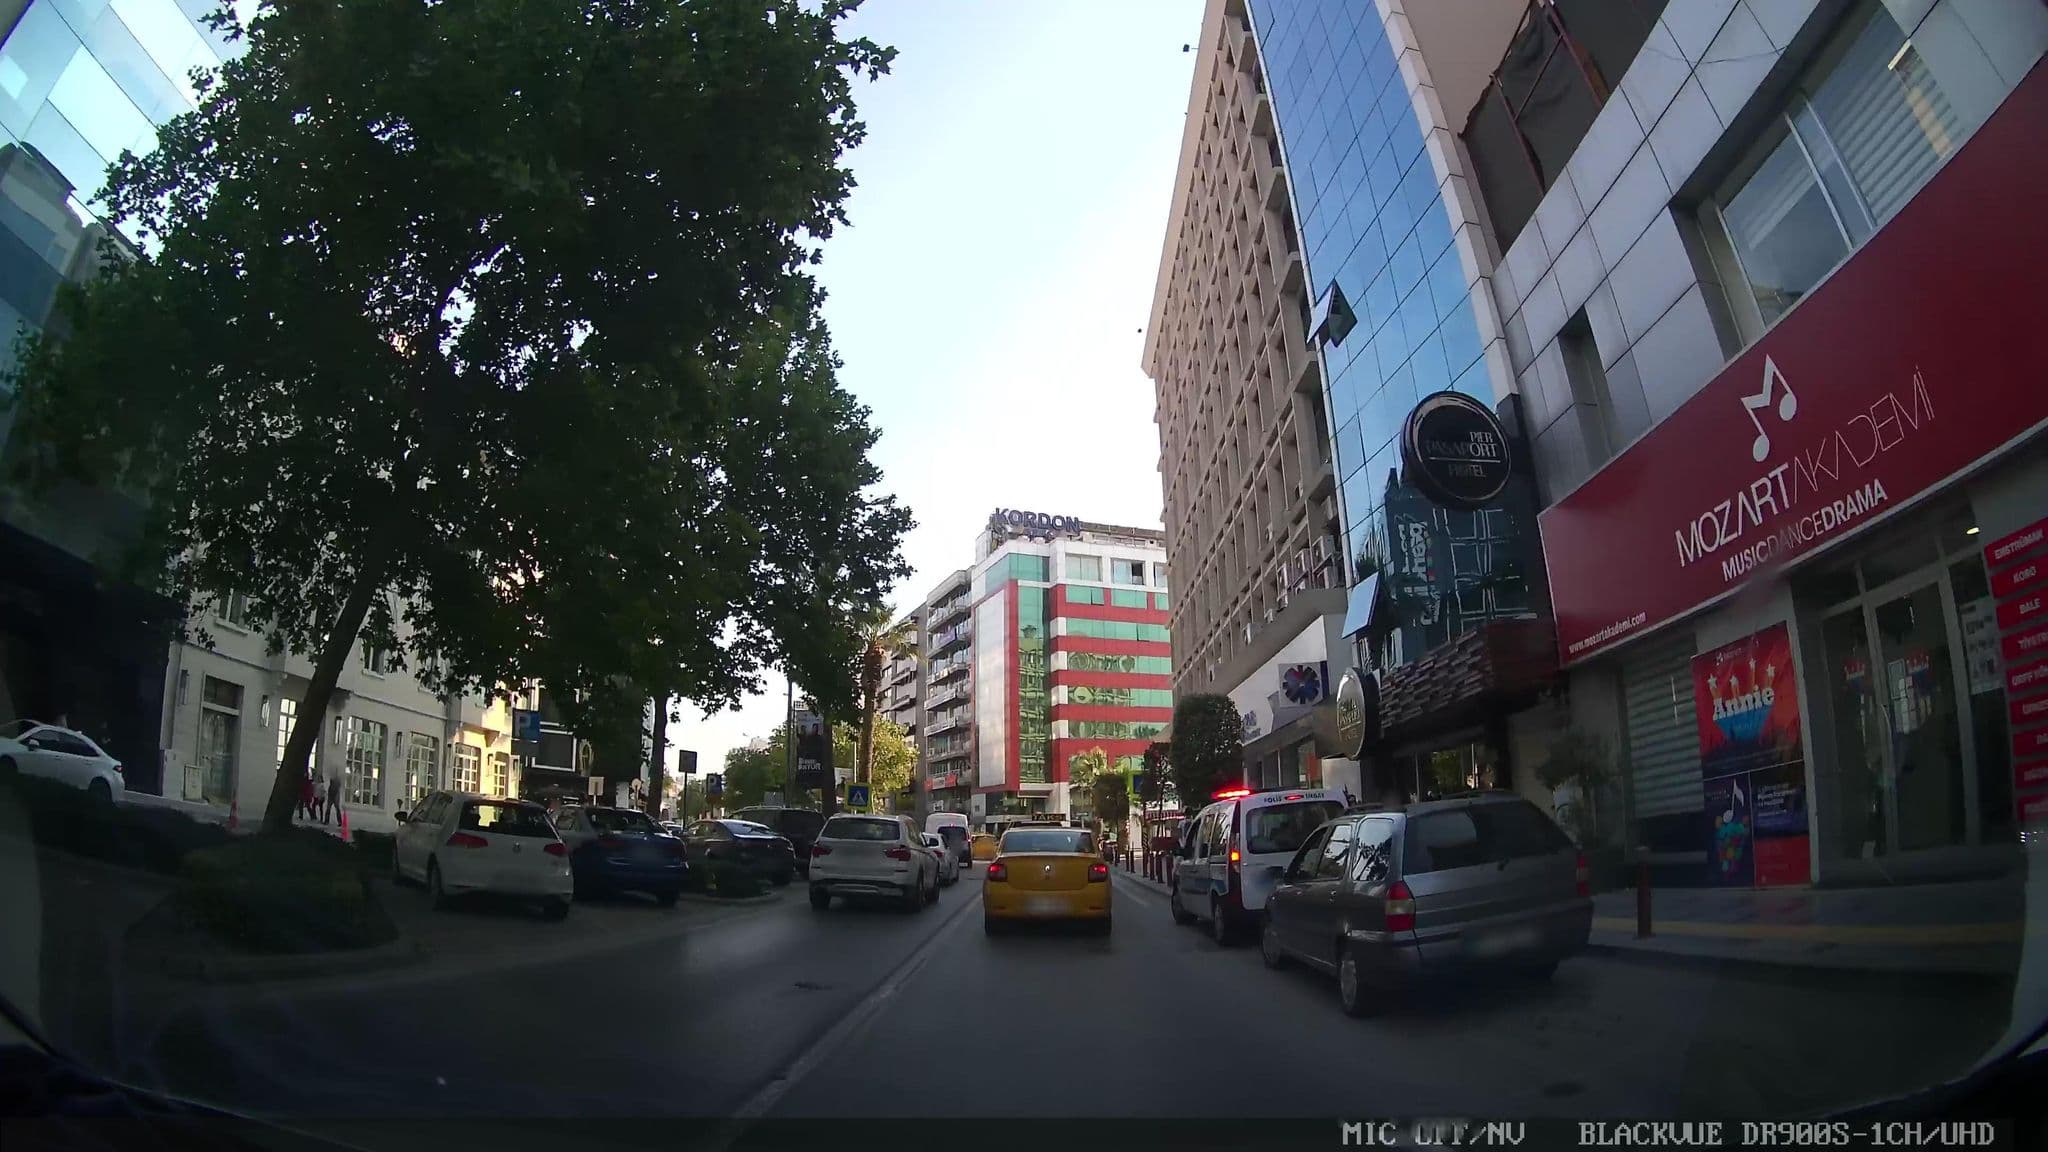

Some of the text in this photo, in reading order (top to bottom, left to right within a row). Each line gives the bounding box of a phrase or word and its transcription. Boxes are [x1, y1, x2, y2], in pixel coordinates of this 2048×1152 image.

[1469, 431, 1494, 443] PIER
[996, 507, 1080, 533] KORDON
[1568, 611, 1647, 654] www.mozartakademi.com
[1712, 681, 1775, 721] Annie
